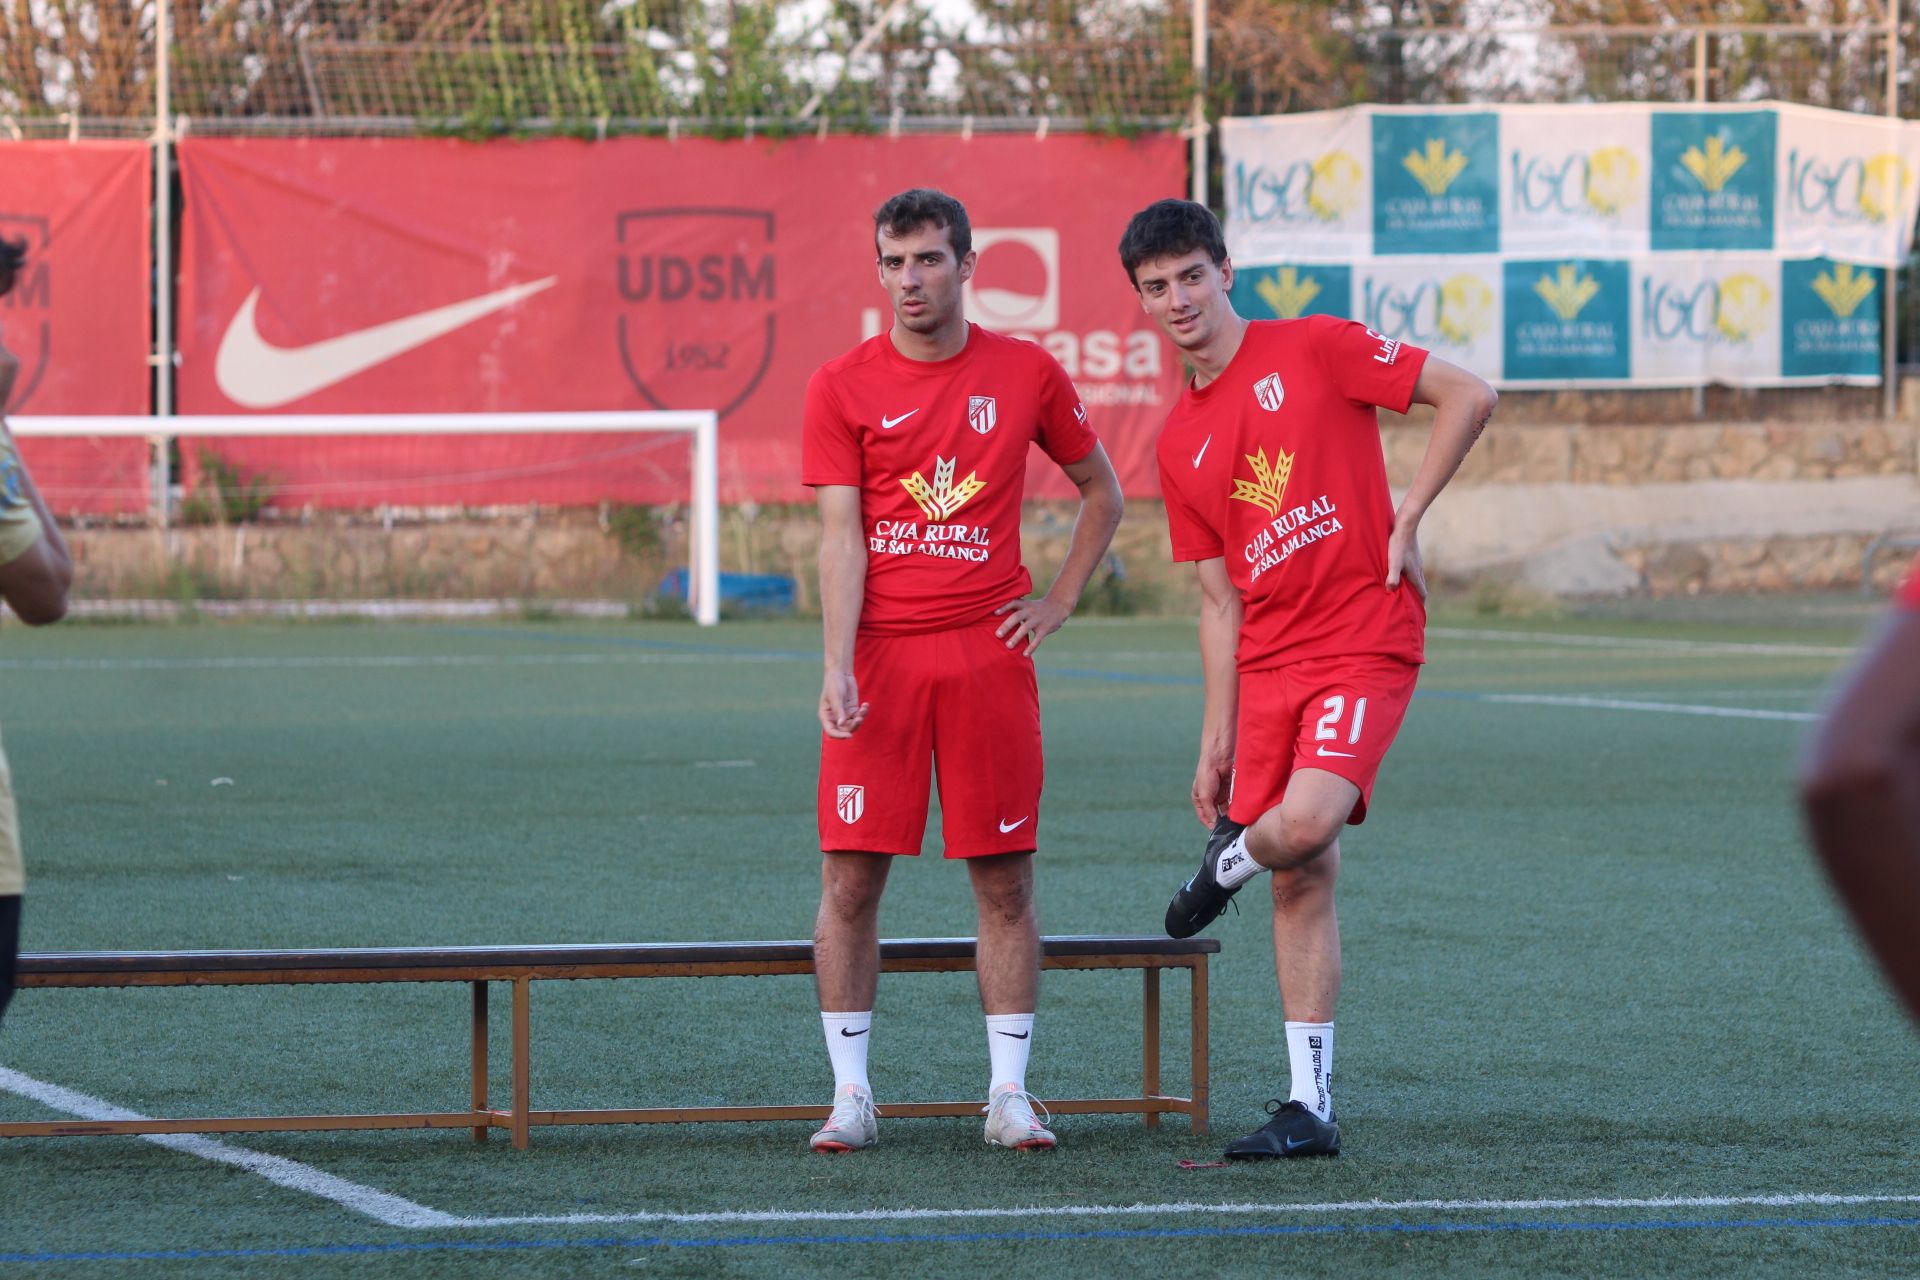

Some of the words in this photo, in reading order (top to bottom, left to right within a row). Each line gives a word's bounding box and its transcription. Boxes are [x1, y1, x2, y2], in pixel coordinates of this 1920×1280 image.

[618, 253, 775, 302] UDSM
[869, 537, 886, 553] DE
[888, 540, 989, 562] SALAMANCA
[875, 520, 919, 540] CAJA
[923, 524, 990, 546] RURAL
[1244, 528, 1274, 563] CAJA
[1270, 495, 1336, 539] RURAL
[1260, 517, 1343, 572] SALAMANCA
[1315, 695, 1367, 745] 21
[1310, 1036, 1321, 1049] FS
